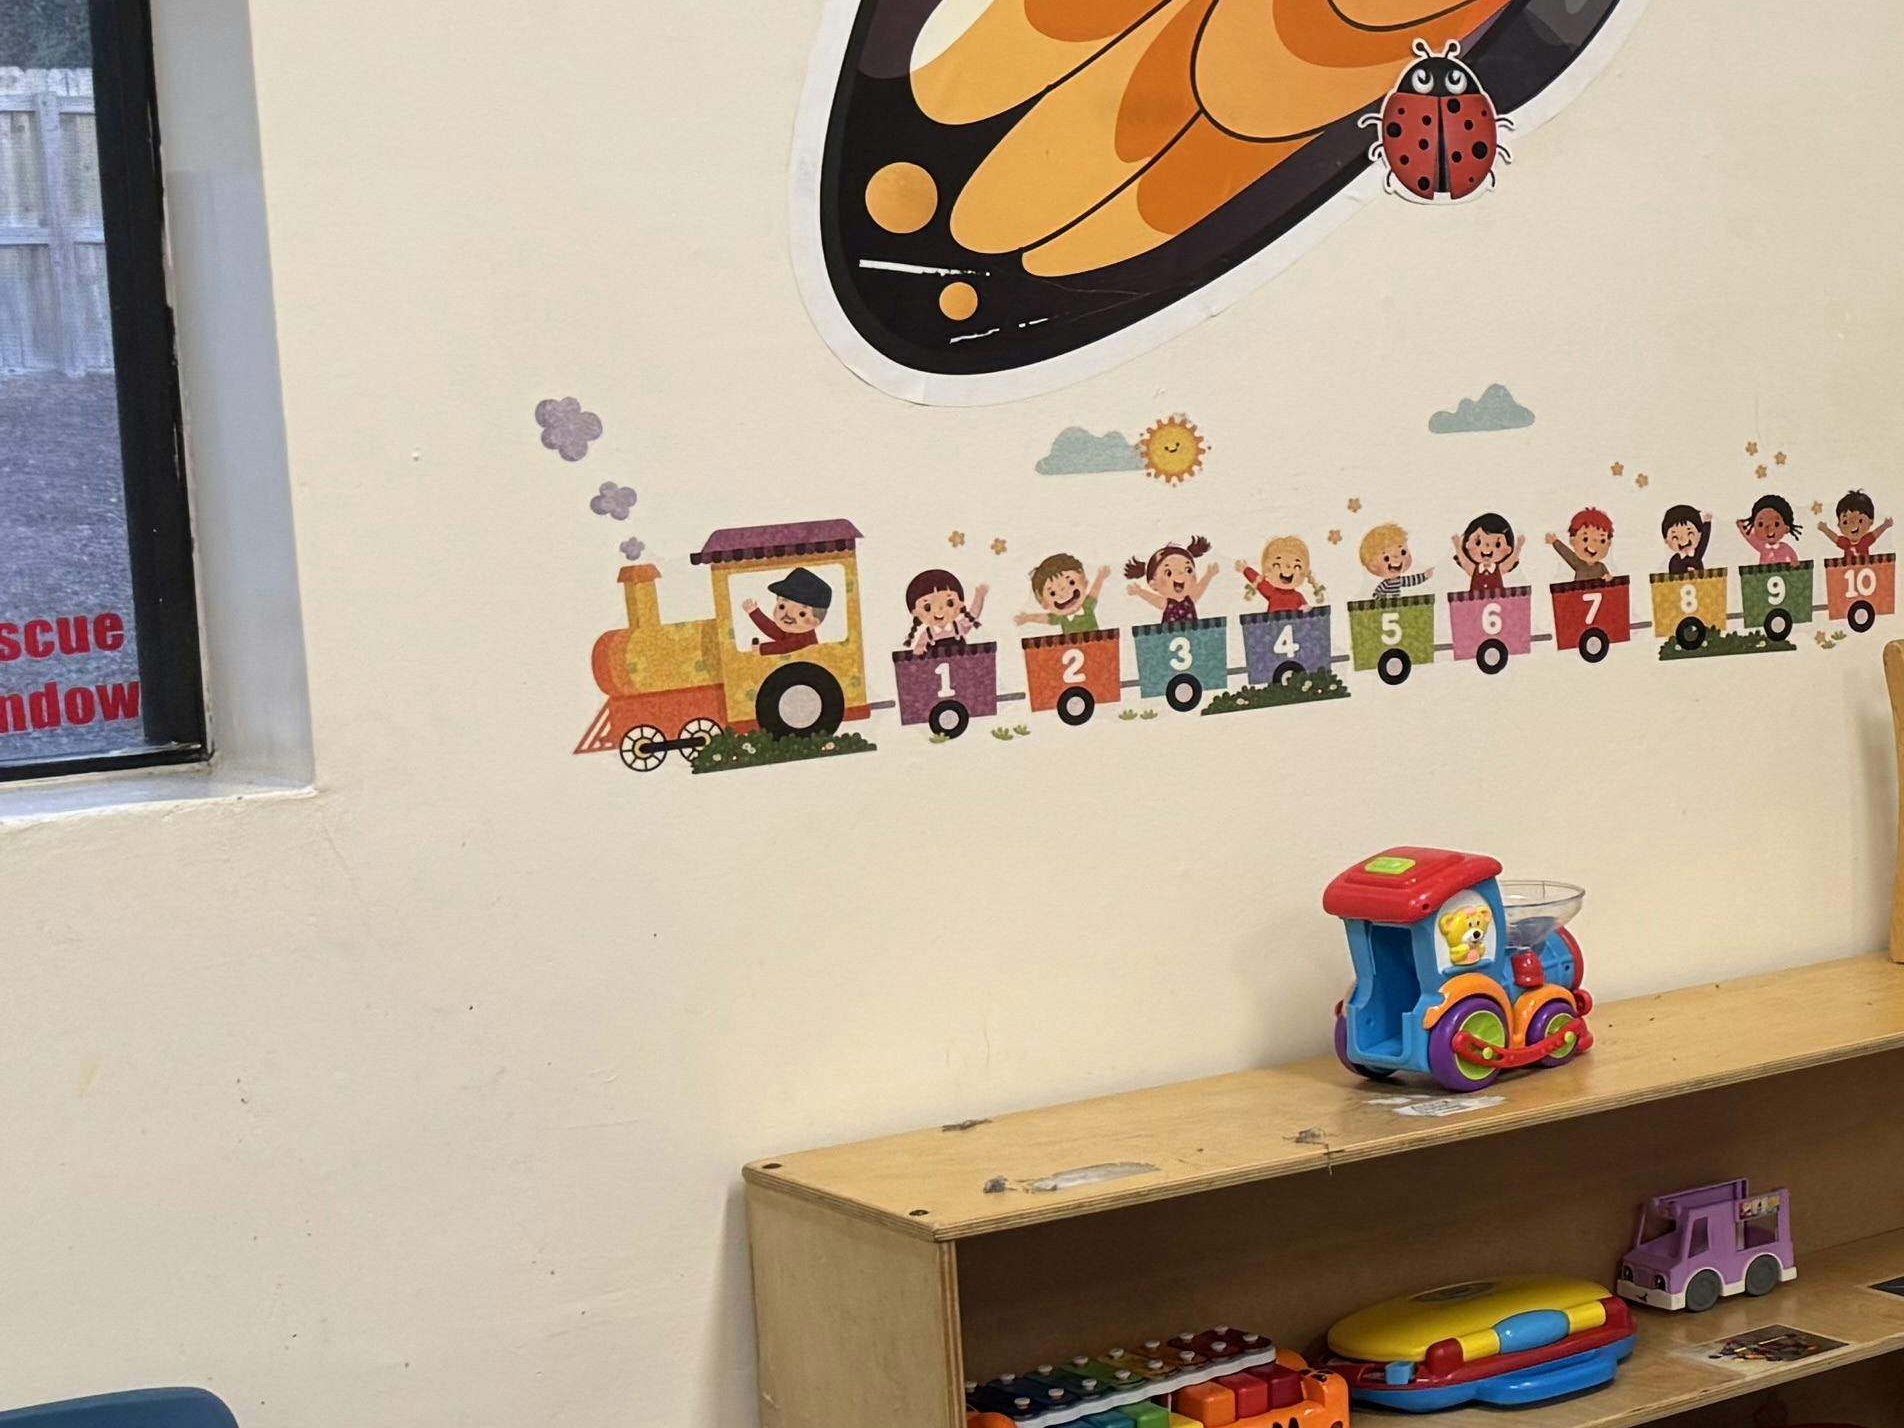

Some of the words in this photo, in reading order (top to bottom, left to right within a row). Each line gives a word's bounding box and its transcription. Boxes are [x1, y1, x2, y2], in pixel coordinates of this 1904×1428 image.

[1679, 584, 1698, 613] 8
[1767, 576, 1784, 605] 9
[1844, 568, 1876, 599] 10
[1482, 603, 1502, 634] 6
[1582, 593, 1603, 624] 7
[1273, 625, 1299, 659] 4
[1381, 612, 1402, 643] 5
[1062, 649, 1085, 683] 2
[1169, 637, 1193, 670] 3
[935, 663, 955, 698] 1
